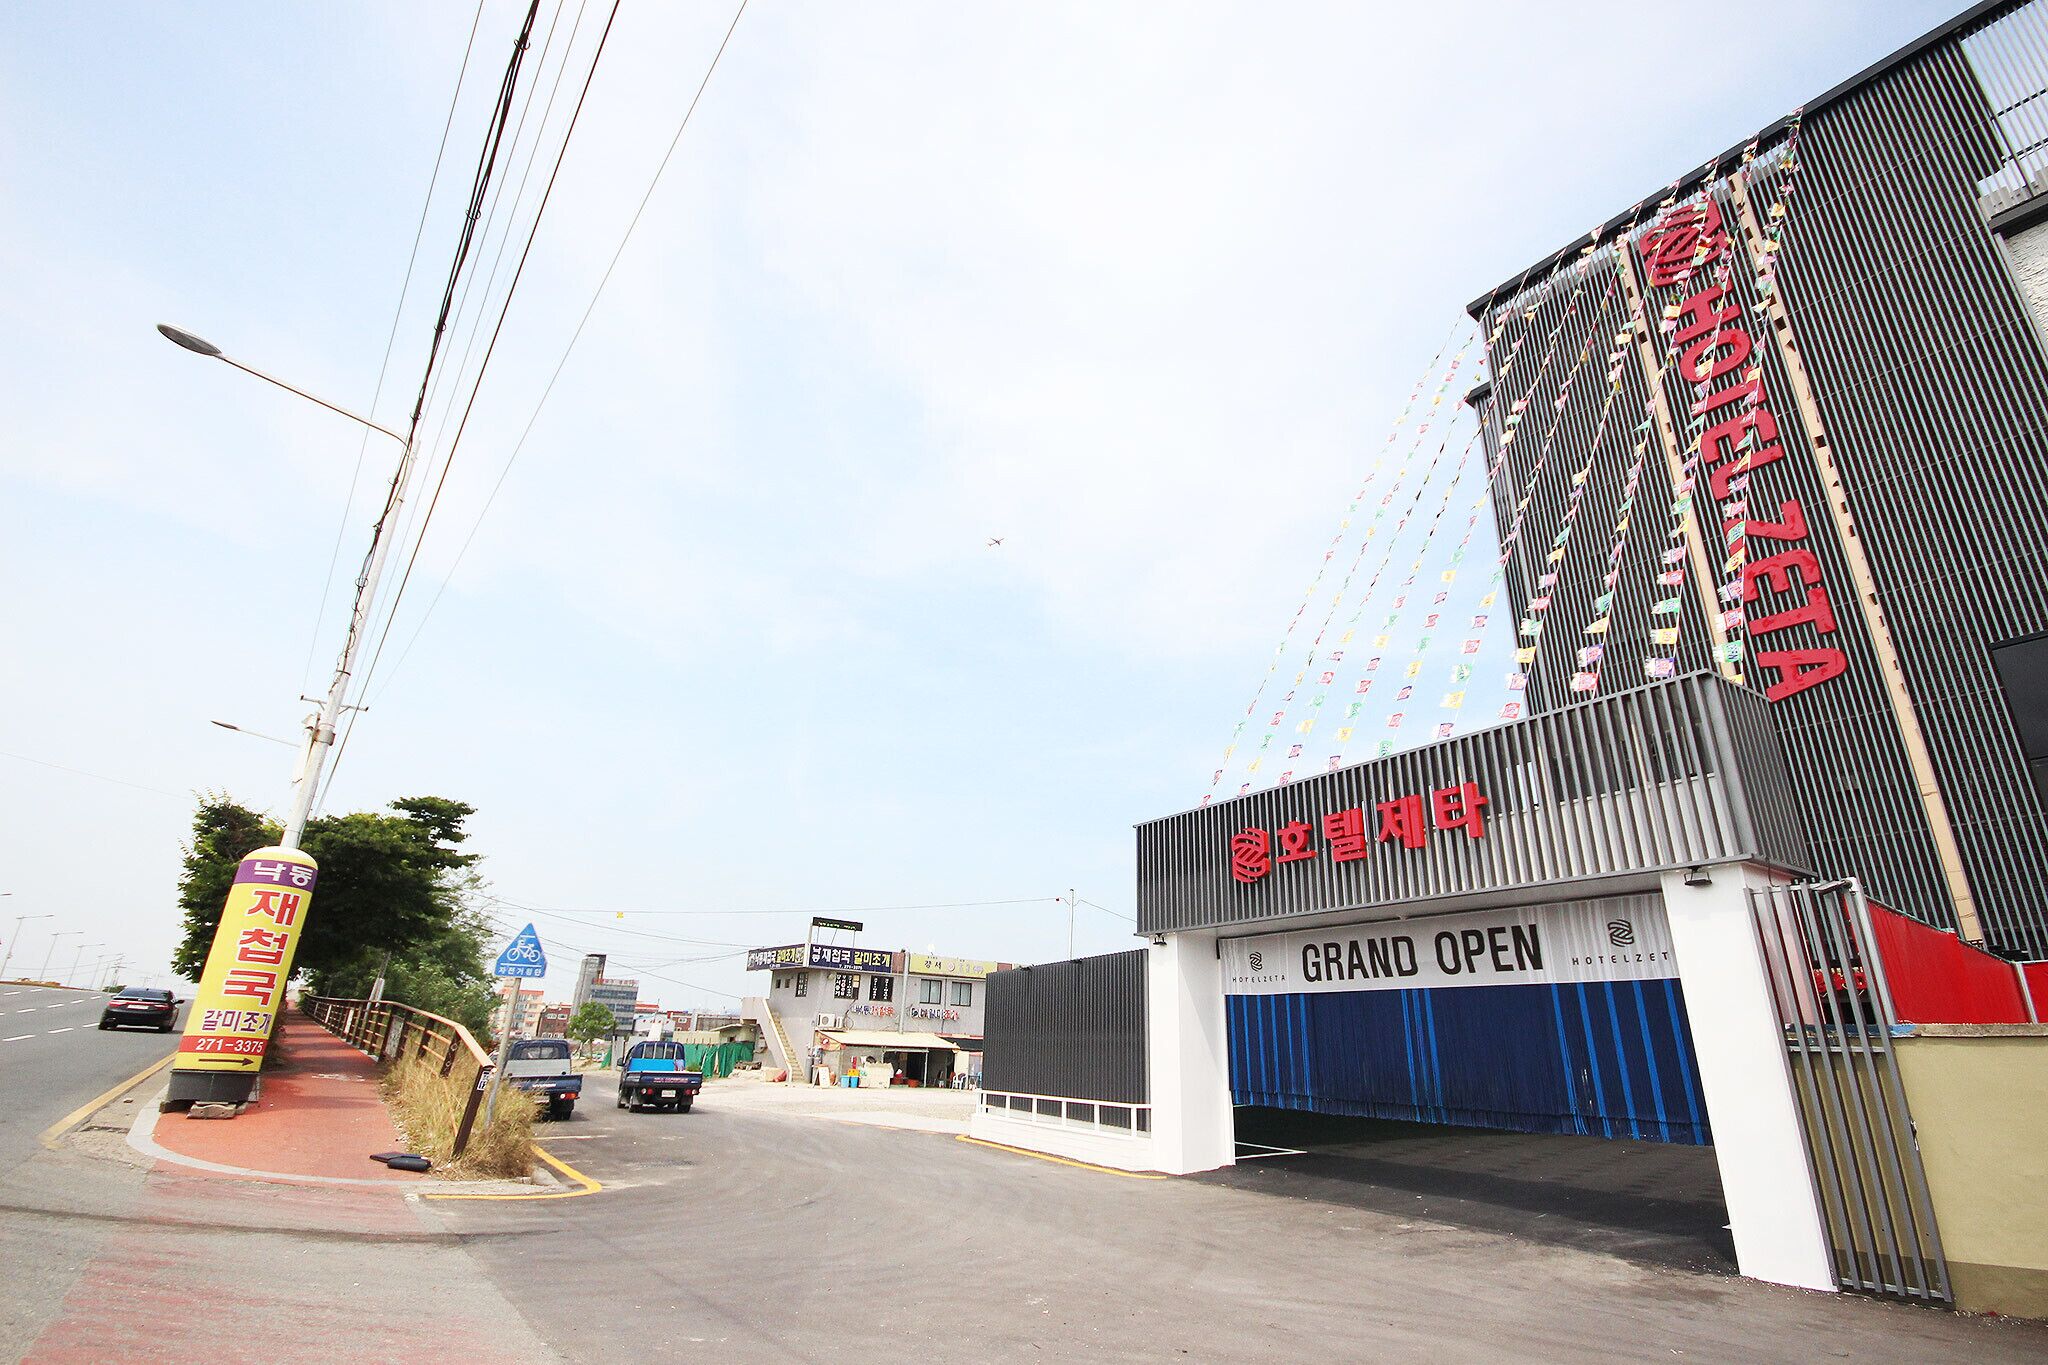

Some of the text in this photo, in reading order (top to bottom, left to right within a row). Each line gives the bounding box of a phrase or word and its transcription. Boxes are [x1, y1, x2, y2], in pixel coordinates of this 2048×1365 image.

[1673, 282, 1848, 704] HOTEL ZETA
[253, 860, 314, 888] 낙동
[223, 888, 302, 1007] 재첩국
[1301, 923, 1544, 984] GRAND OPEN
[1572, 951, 1669, 966] HOTELZET
[1232, 974, 1286, 984] HOTELZETA
[201, 1008, 274, 1036] 갈미조개
[195, 1036, 264, 1054] 271-3375
